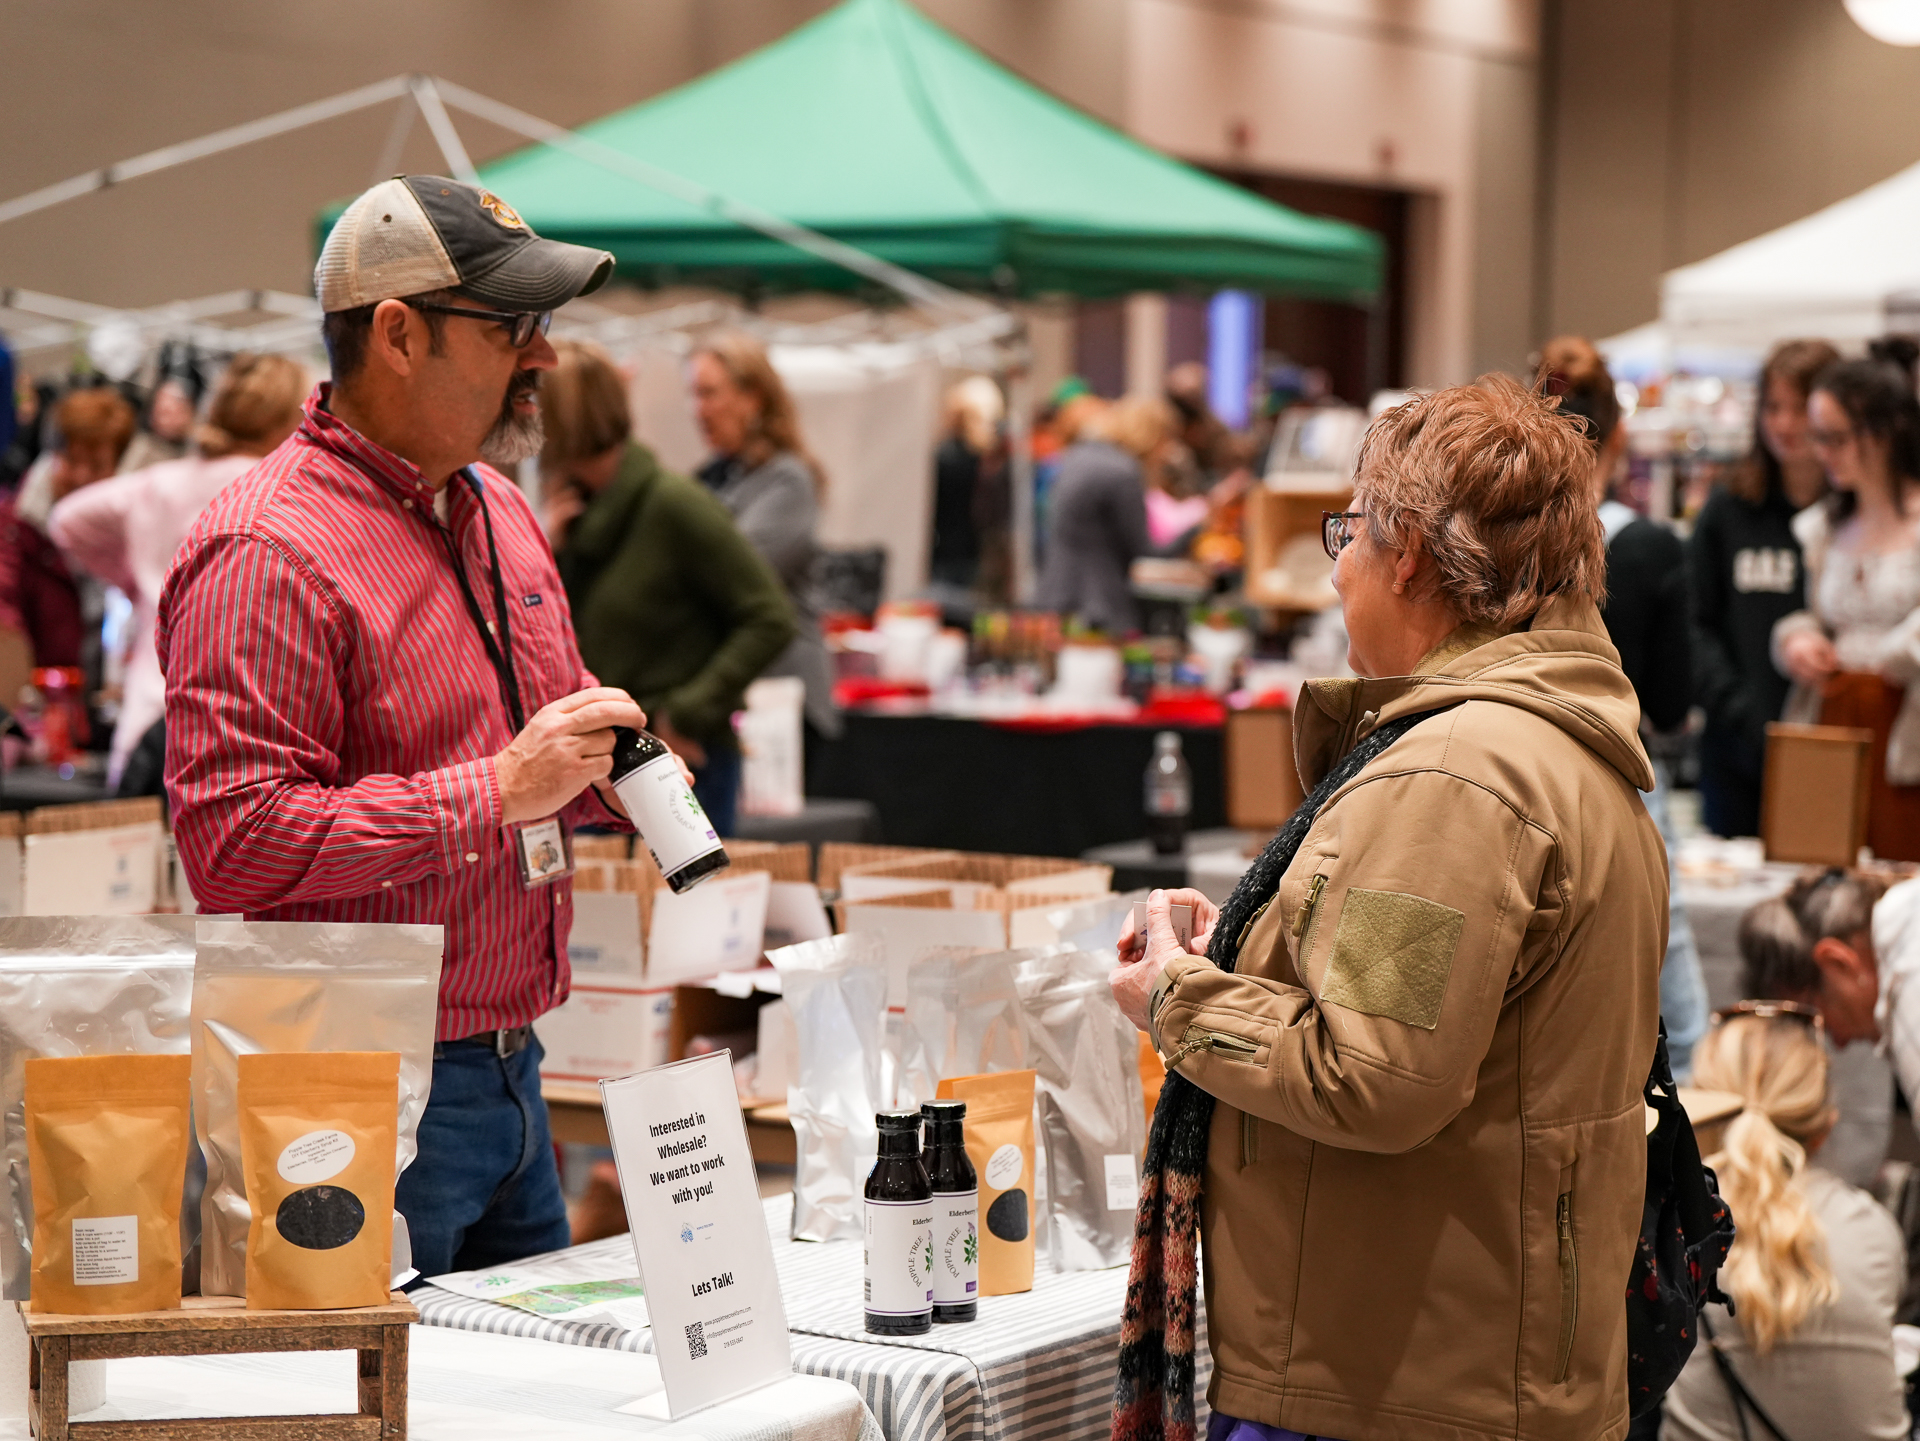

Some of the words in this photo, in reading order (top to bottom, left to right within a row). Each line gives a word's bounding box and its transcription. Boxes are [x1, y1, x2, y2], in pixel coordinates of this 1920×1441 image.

[649, 1113, 695, 1138] Interested
[695, 1112, 706, 1126] in
[657, 1134, 707, 1160] Wholesale?
[649, 1171, 666, 1186] We
[666, 1165, 690, 1182] want
[690, 1162, 701, 1175] to
[701, 1154, 725, 1172] work
[672, 1187, 693, 1204] with
[693, 1181, 714, 1202] you!
[909, 1235, 924, 1256] TREE
[946, 1227, 962, 1247] TREE
[908, 1257, 922, 1288] POPPLE
[945, 1248, 960, 1279] POPPLE
[691, 1281, 712, 1297] Lets
[711, 1271, 734, 1290] Talk!
